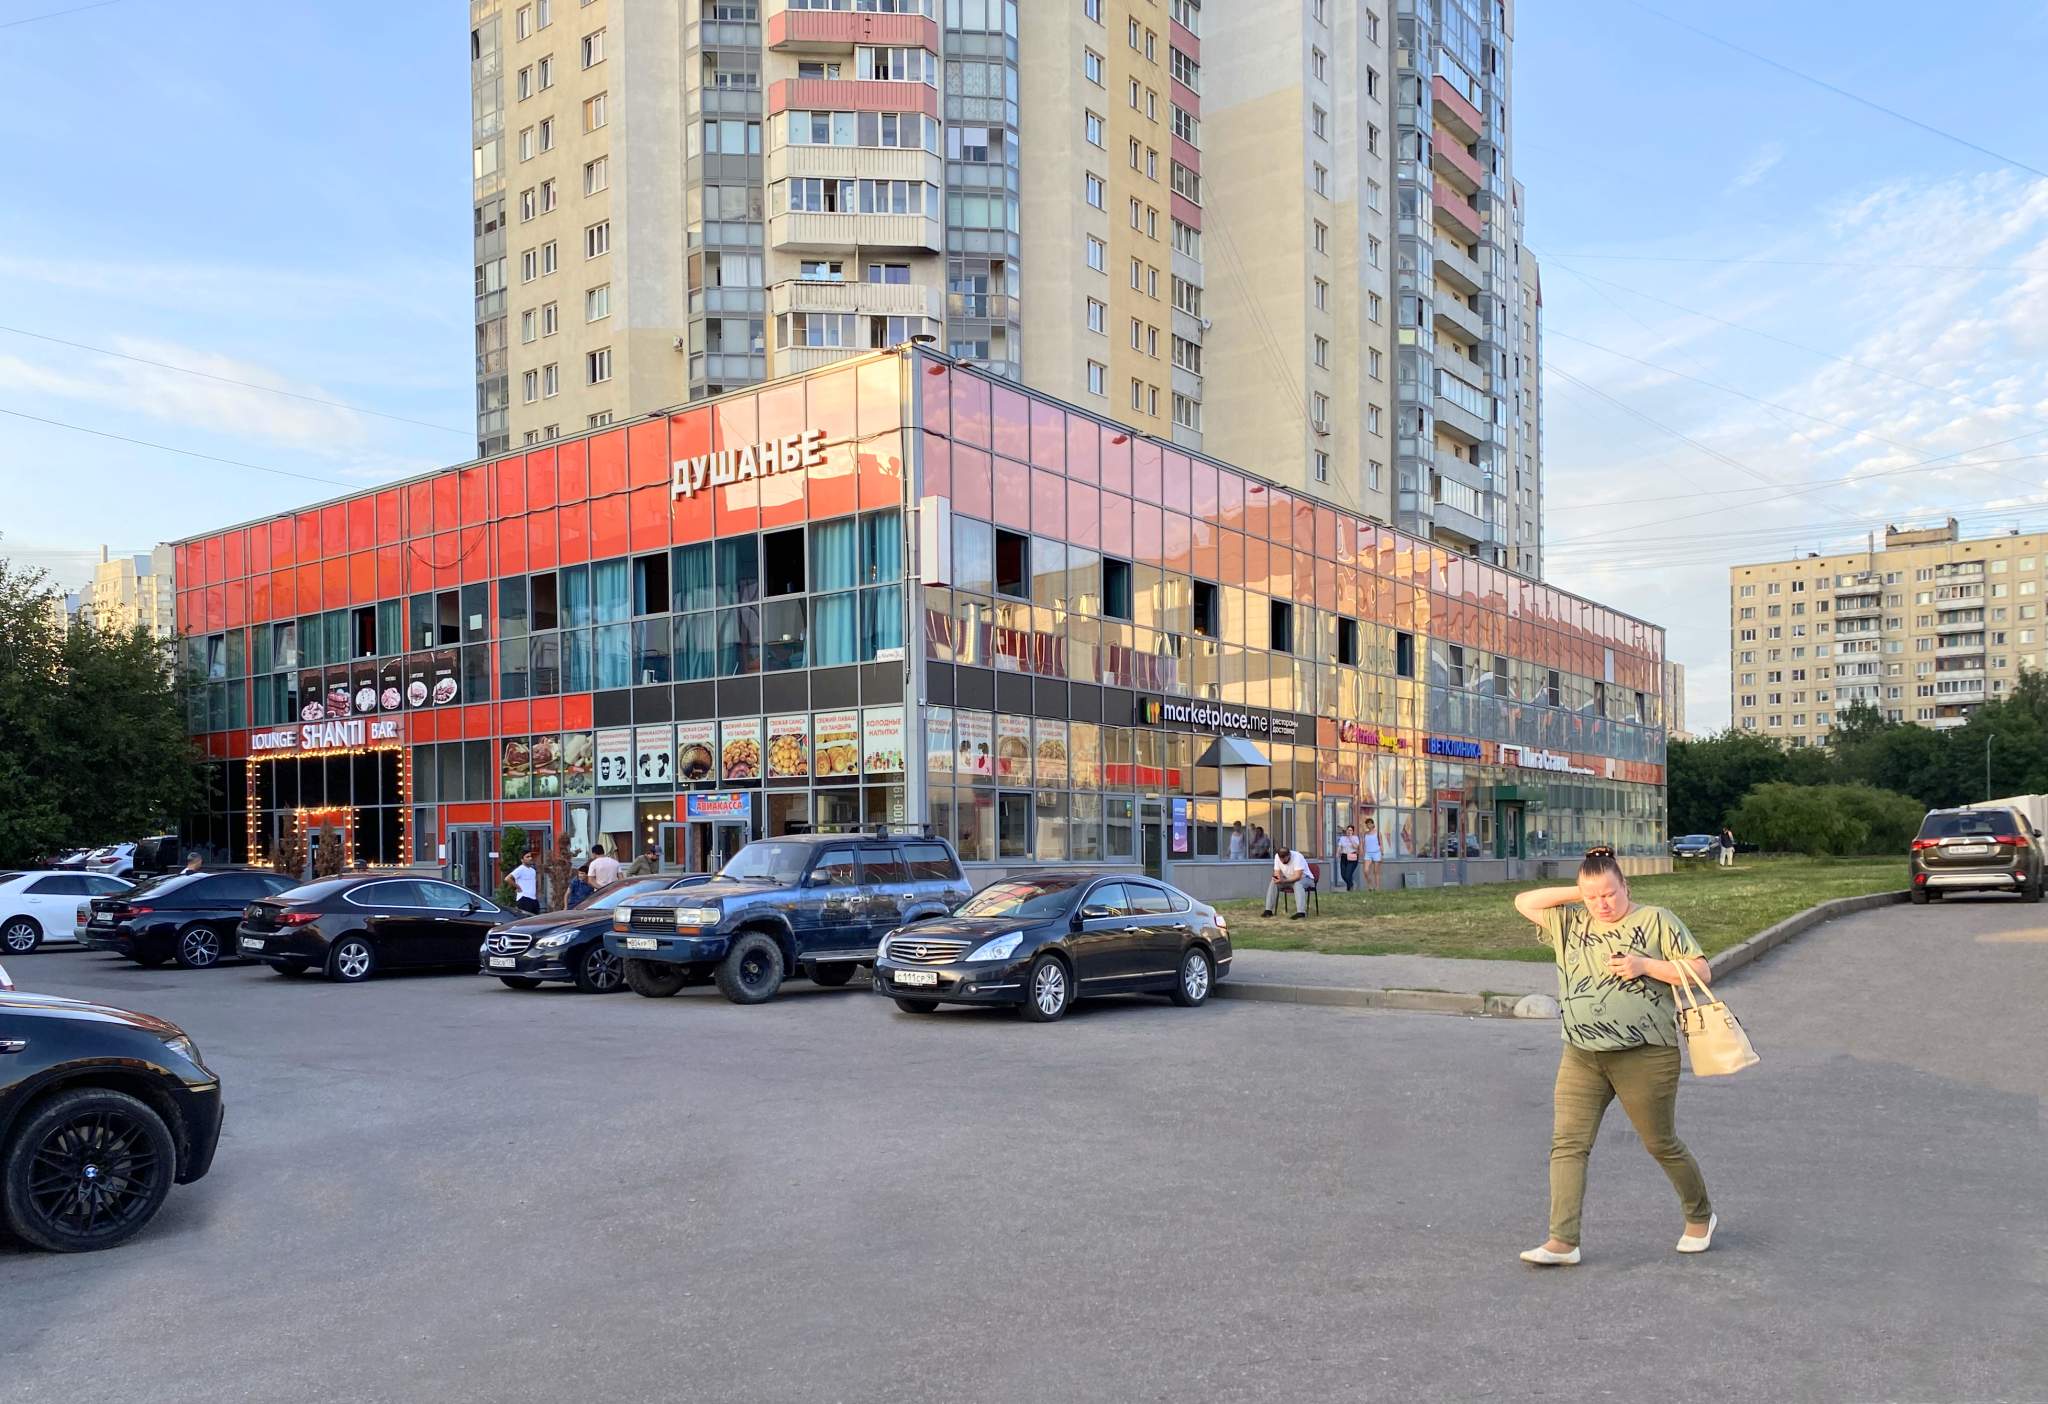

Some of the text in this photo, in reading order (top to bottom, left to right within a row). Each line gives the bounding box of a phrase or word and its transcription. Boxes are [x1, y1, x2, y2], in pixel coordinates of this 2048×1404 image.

[671, 428, 824, 501] ДУШАНБЕ
[866, 717, 901, 727] ХОЛОДНЫЕ
[1163, 702, 1268, 732] marketplace.me
[252, 719, 397, 750] LOUNGE SHANTI BAR
[869, 728, 898, 736] НАПИТКИ
[1430, 737, 1481, 760] ВЕТКЛИНИКА
[696, 800, 743, 811] АВИАКАССА
